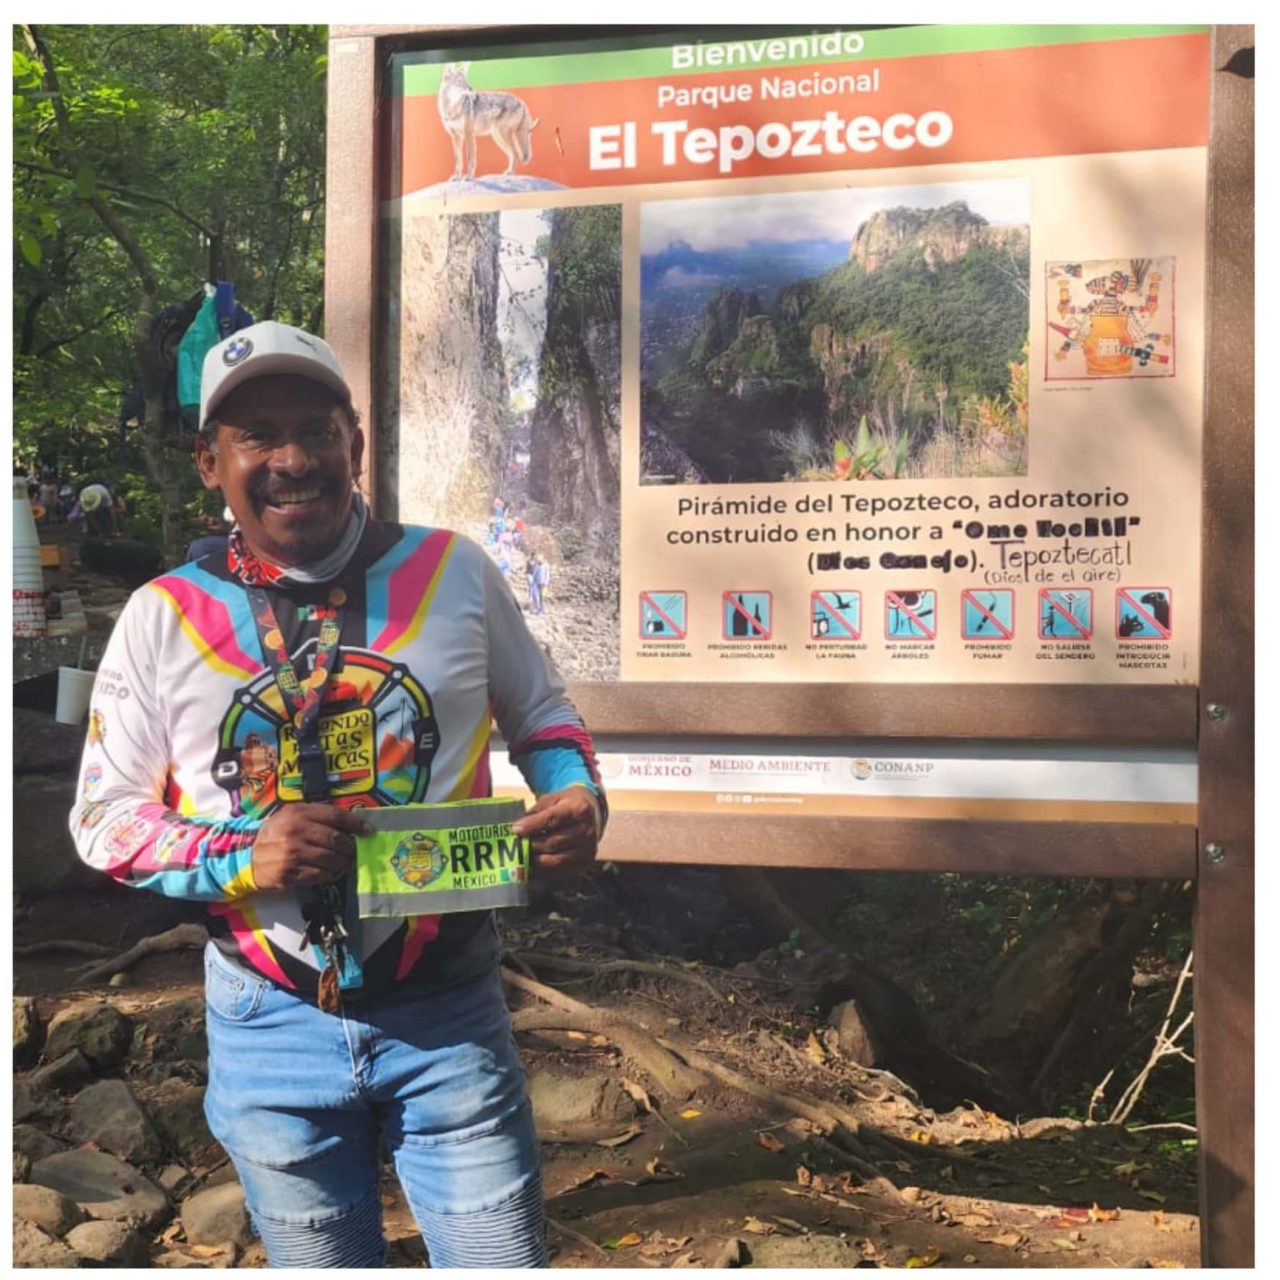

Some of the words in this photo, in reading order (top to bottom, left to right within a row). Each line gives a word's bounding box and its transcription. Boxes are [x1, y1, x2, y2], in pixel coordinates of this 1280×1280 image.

[671, 31, 866, 69] Bienvenido
[657, 82, 754, 109] Parque
[759, 68, 881, 101] Nacional
[588, 120, 637, 171] El
[651, 109, 954, 174] Tepozteco
[677, 495, 788, 516] Pirámide
[794, 494, 833, 513] del
[840, 493, 980, 517] Tepozteco,
[987, 486, 1130, 509] adoratorio
[666, 523, 799, 545] construido
[805, 527, 837, 542] en
[844, 523, 922, 541] honor
[929, 526, 943, 540] a
[1034, 567, 1054, 583] de
[628, 762, 693, 777] MÉXICO
[709, 758, 755, 771] MEDIO
[758, 759, 832, 773] AMBIENTE
[874, 760, 935, 774] CONANP
[448, 823, 515, 844] MOTOTURIS
[450, 838, 525, 875] RRM
